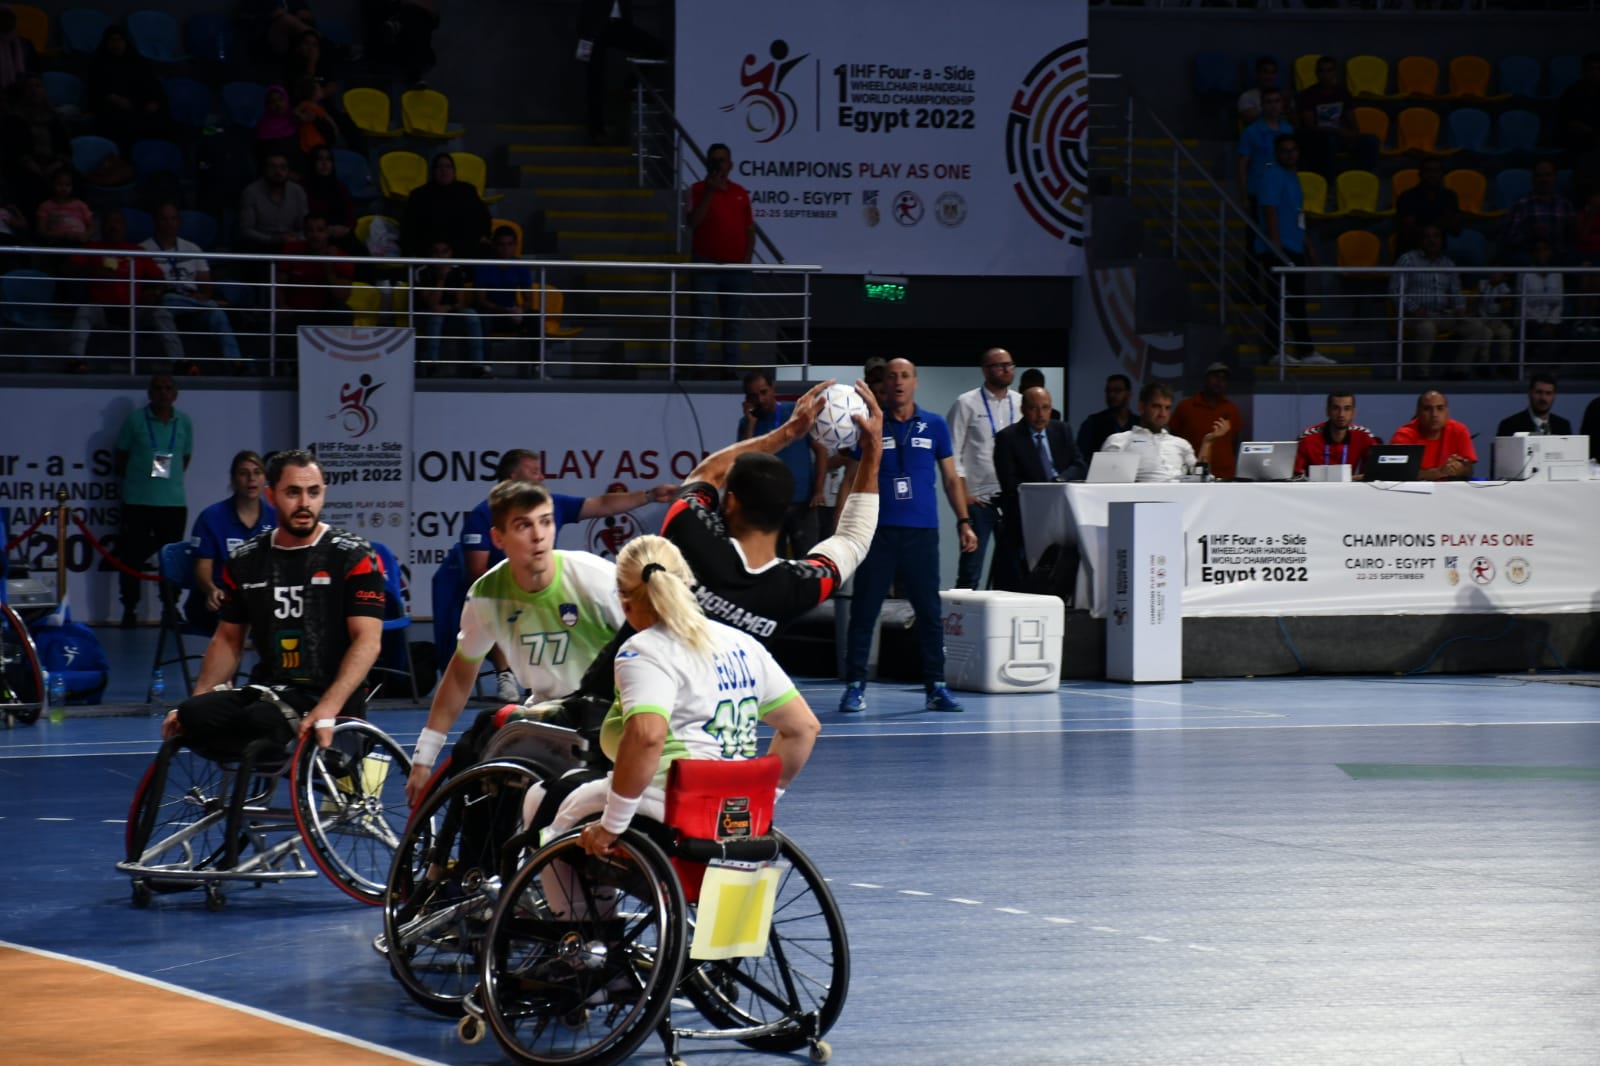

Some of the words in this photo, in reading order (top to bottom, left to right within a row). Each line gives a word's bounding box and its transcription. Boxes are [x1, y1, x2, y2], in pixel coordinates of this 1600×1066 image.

[850, 64, 876, 78] IHF
[879, 64, 912, 79] Four
[923, 68, 932, 80] a
[943, 65, 975, 80] Side
[833, 63, 847, 103] 1
[850, 81, 918, 92] WHEELCHAIR
[920, 82, 975, 93] HANDBALL
[850, 94, 890, 104] WORLD
[892, 94, 975, 105] CHAMPIONSHIP
[838, 106, 909, 133] Egypt
[915, 108, 975, 129] 2022
[739, 160, 853, 178] CHAMPIONS
[859, 162, 901, 179] PLAY
[906, 163, 929, 179] AS
[934, 163, 972, 180] ONE
[803, 191, 852, 205] EGYPT
[783, 209, 838, 218] SEPTEMBER
[46, 455, 65, 476] a
[541, 450, 606, 480] LAY
[614, 450, 659, 480] AS
[323, 469, 358, 485] gypt
[362, 468, 402, 482] 2022
[40, 482, 120, 500] HANDB
[897, 481, 909, 494] B
[1210, 534, 1230, 545] IHF
[1232, 534, 1257, 545] Four
[1266, 537, 1273, 545] a
[1282, 534, 1307, 545] Side
[1342, 533, 1436, 548] CHAMPIONS
[1441, 533, 1476, 547] PLAY
[1480, 533, 1499, 547] AS
[1502, 533, 1534, 547] ONE
[1198, 534, 1208, 564] 1
[1264, 547, 1307, 555] HANDBALL
[1211, 556, 1240, 564] WORLD
[1243, 556, 1307, 564] CHAMPIONSHIP
[1345, 558, 1385, 569] CAIRO
[1396, 558, 1436, 569] EGYPT
[1202, 567, 1257, 585] Egypt
[1261, 566, 1308, 582] 2022
[273, 585, 304, 619] 55
[695, 585, 778, 638] MOHAMED
[521, 630, 570, 666] 77
